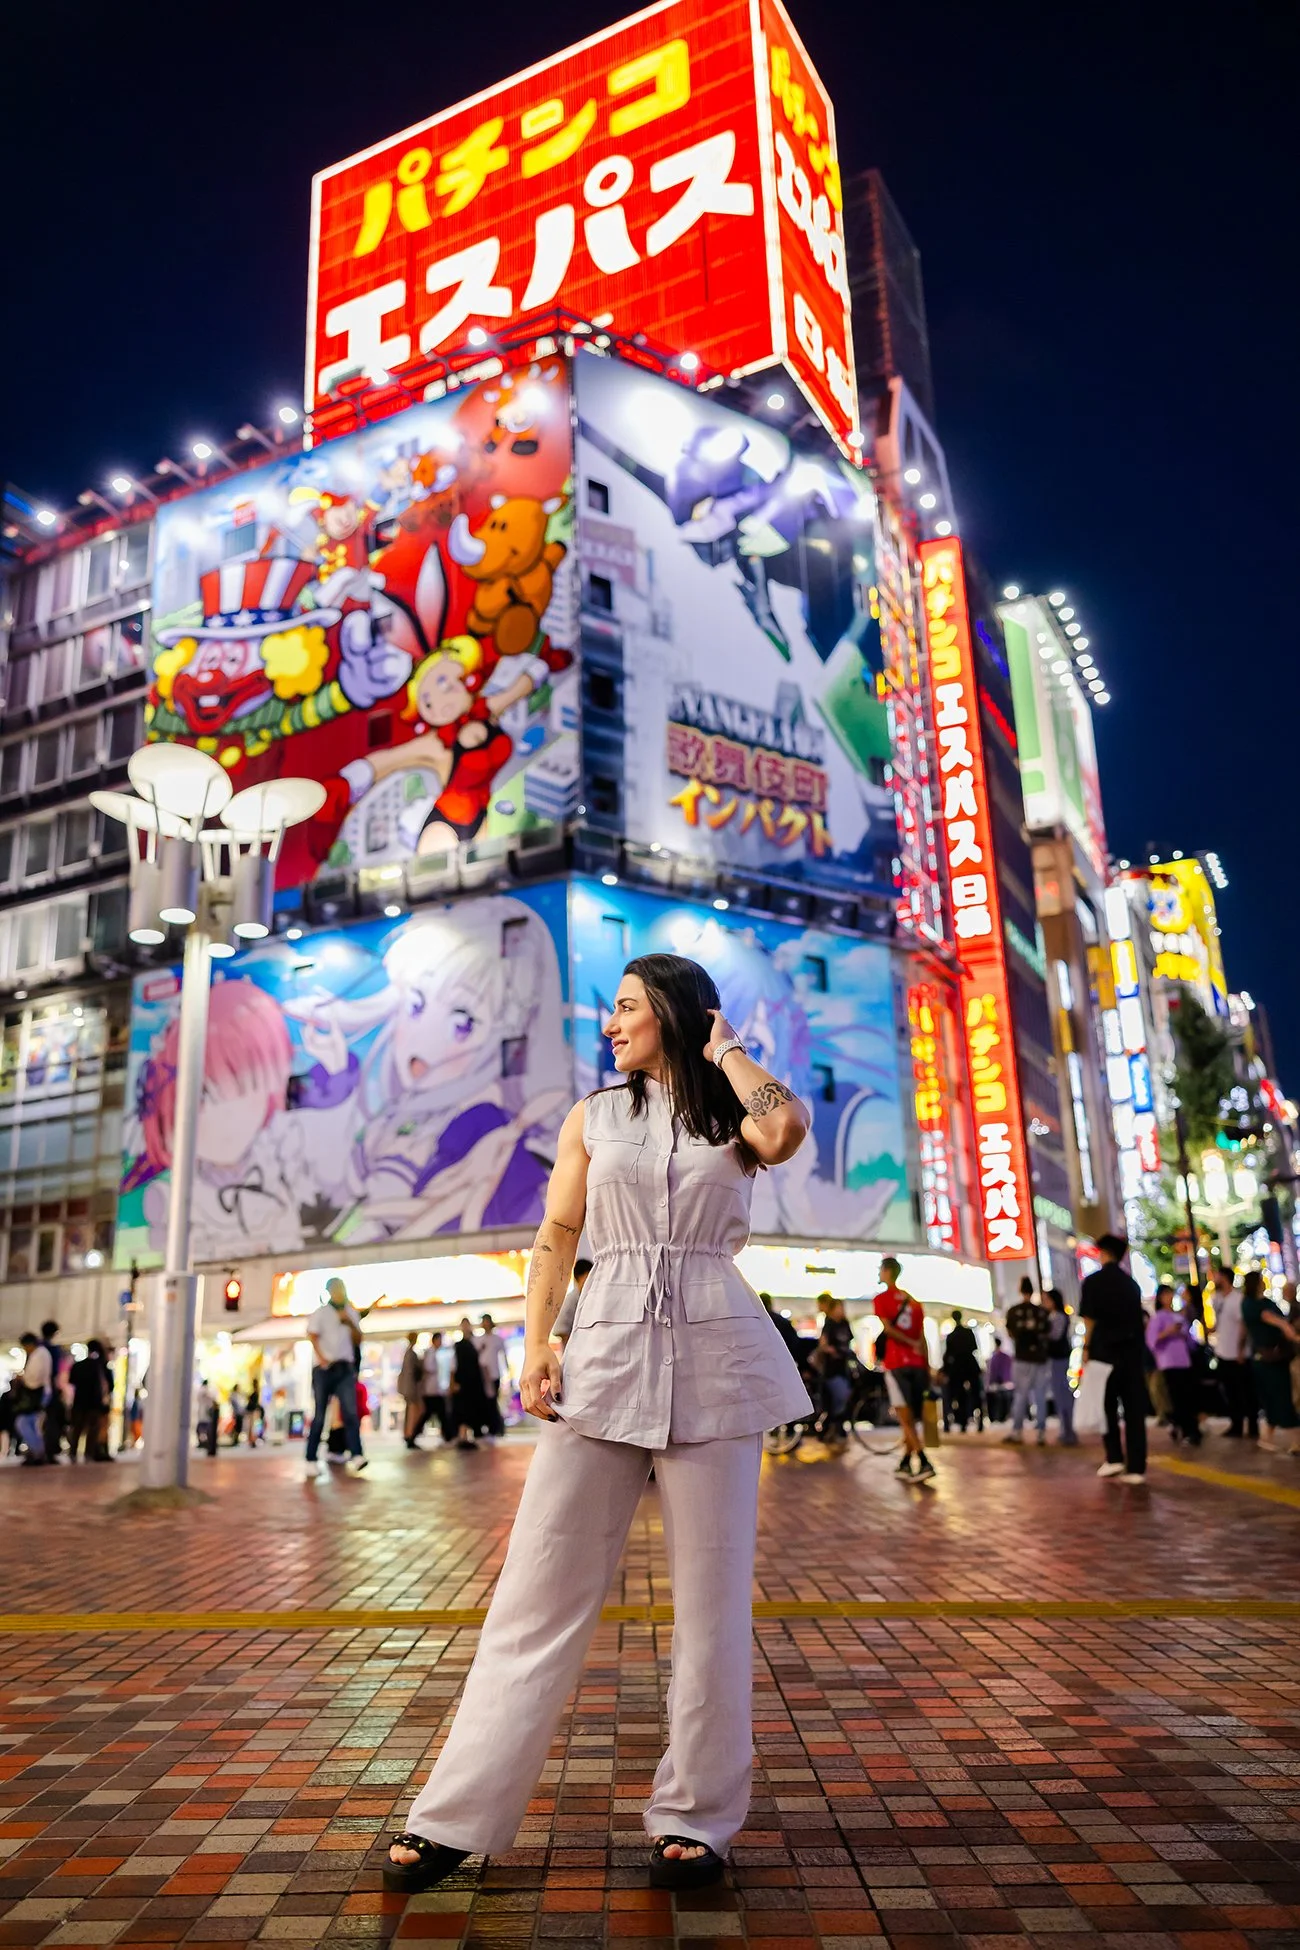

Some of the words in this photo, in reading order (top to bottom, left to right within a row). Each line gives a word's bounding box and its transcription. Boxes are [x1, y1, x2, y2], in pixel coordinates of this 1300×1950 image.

[353, 39, 691, 258] パチンコ
[318, 130, 755, 394] エスパス
[669, 779, 833, 858] インパクト
[935, 683, 983, 868] エスパス
[966, 993, 1007, 1113] パチンコ
[978, 1123, 1024, 1253] エスパス
